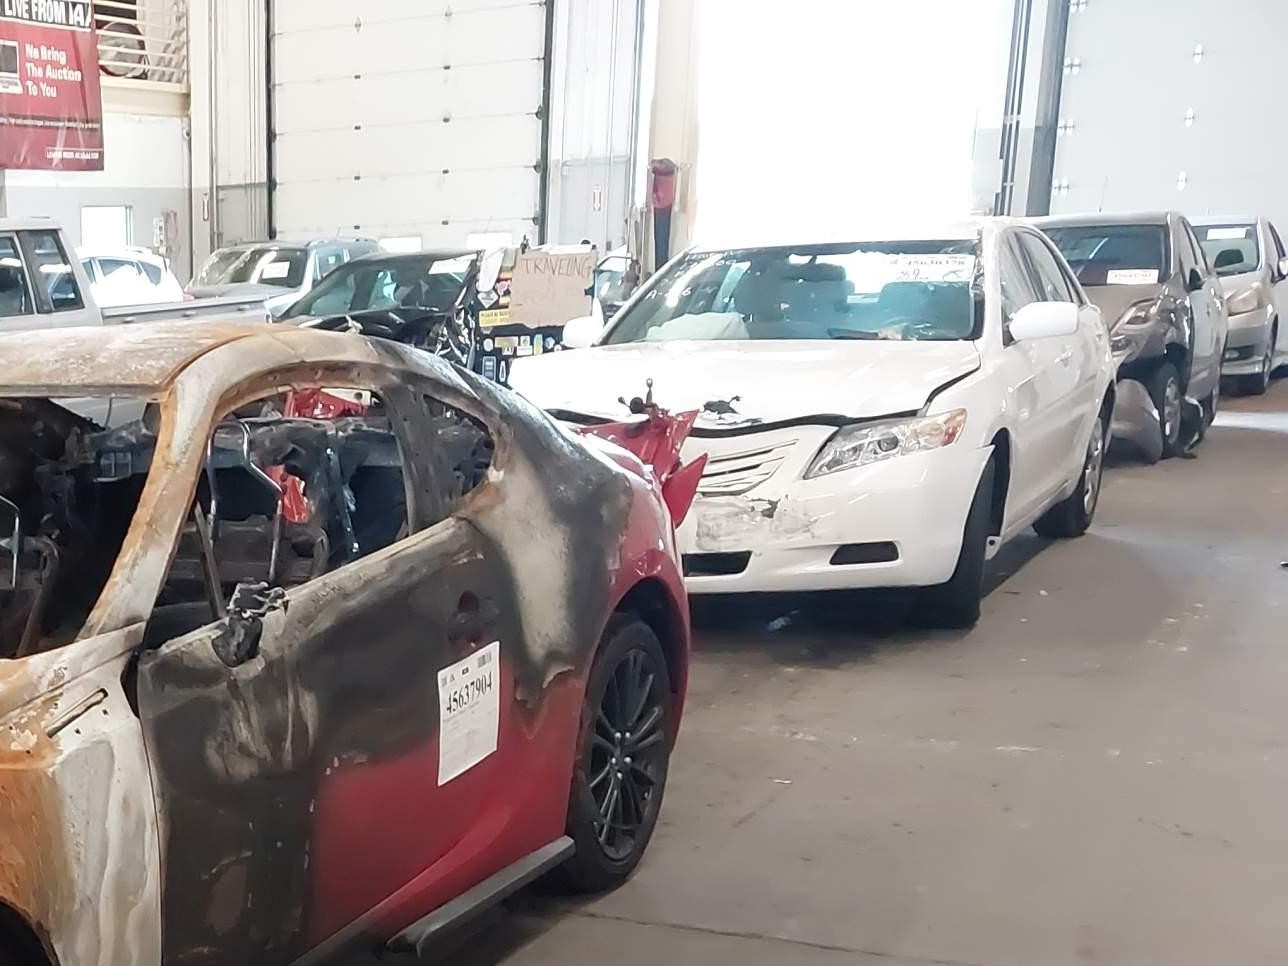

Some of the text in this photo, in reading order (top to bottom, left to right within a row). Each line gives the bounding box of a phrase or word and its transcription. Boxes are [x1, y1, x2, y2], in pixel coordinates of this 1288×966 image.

[4, 0, 30, 19] LIVE
[32, 0, 67, 23] FROM
[40, 45, 66, 65] Bring
[26, 62, 81, 81] The Auction
[26, 80, 57, 97] To You
[446, 671, 493, 714] 45637904
